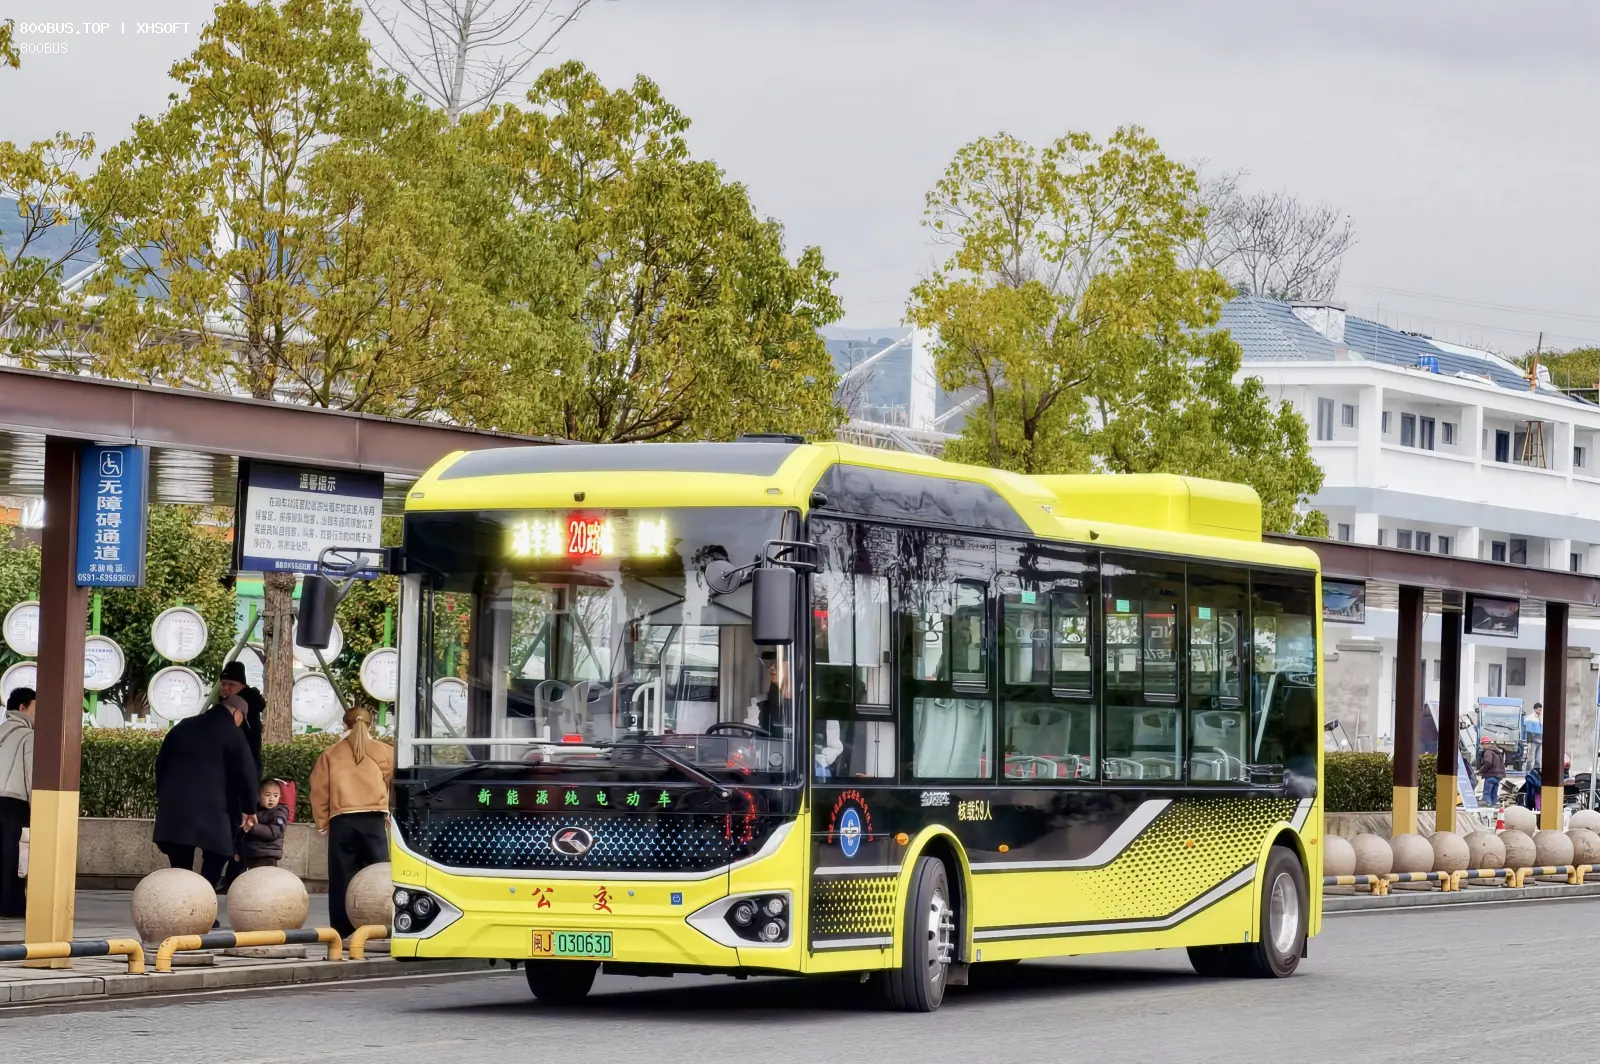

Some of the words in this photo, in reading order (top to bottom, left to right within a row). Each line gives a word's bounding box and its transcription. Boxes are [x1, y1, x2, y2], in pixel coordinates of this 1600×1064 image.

[300, 473, 336, 492] 温馨提示
[93, 480, 123, 561] 无障碍通道
[477, 788, 672, 808] 新能源纯电动车
[957, 800, 993, 821] 核载59人
[531, 885, 613, 914] 公交
